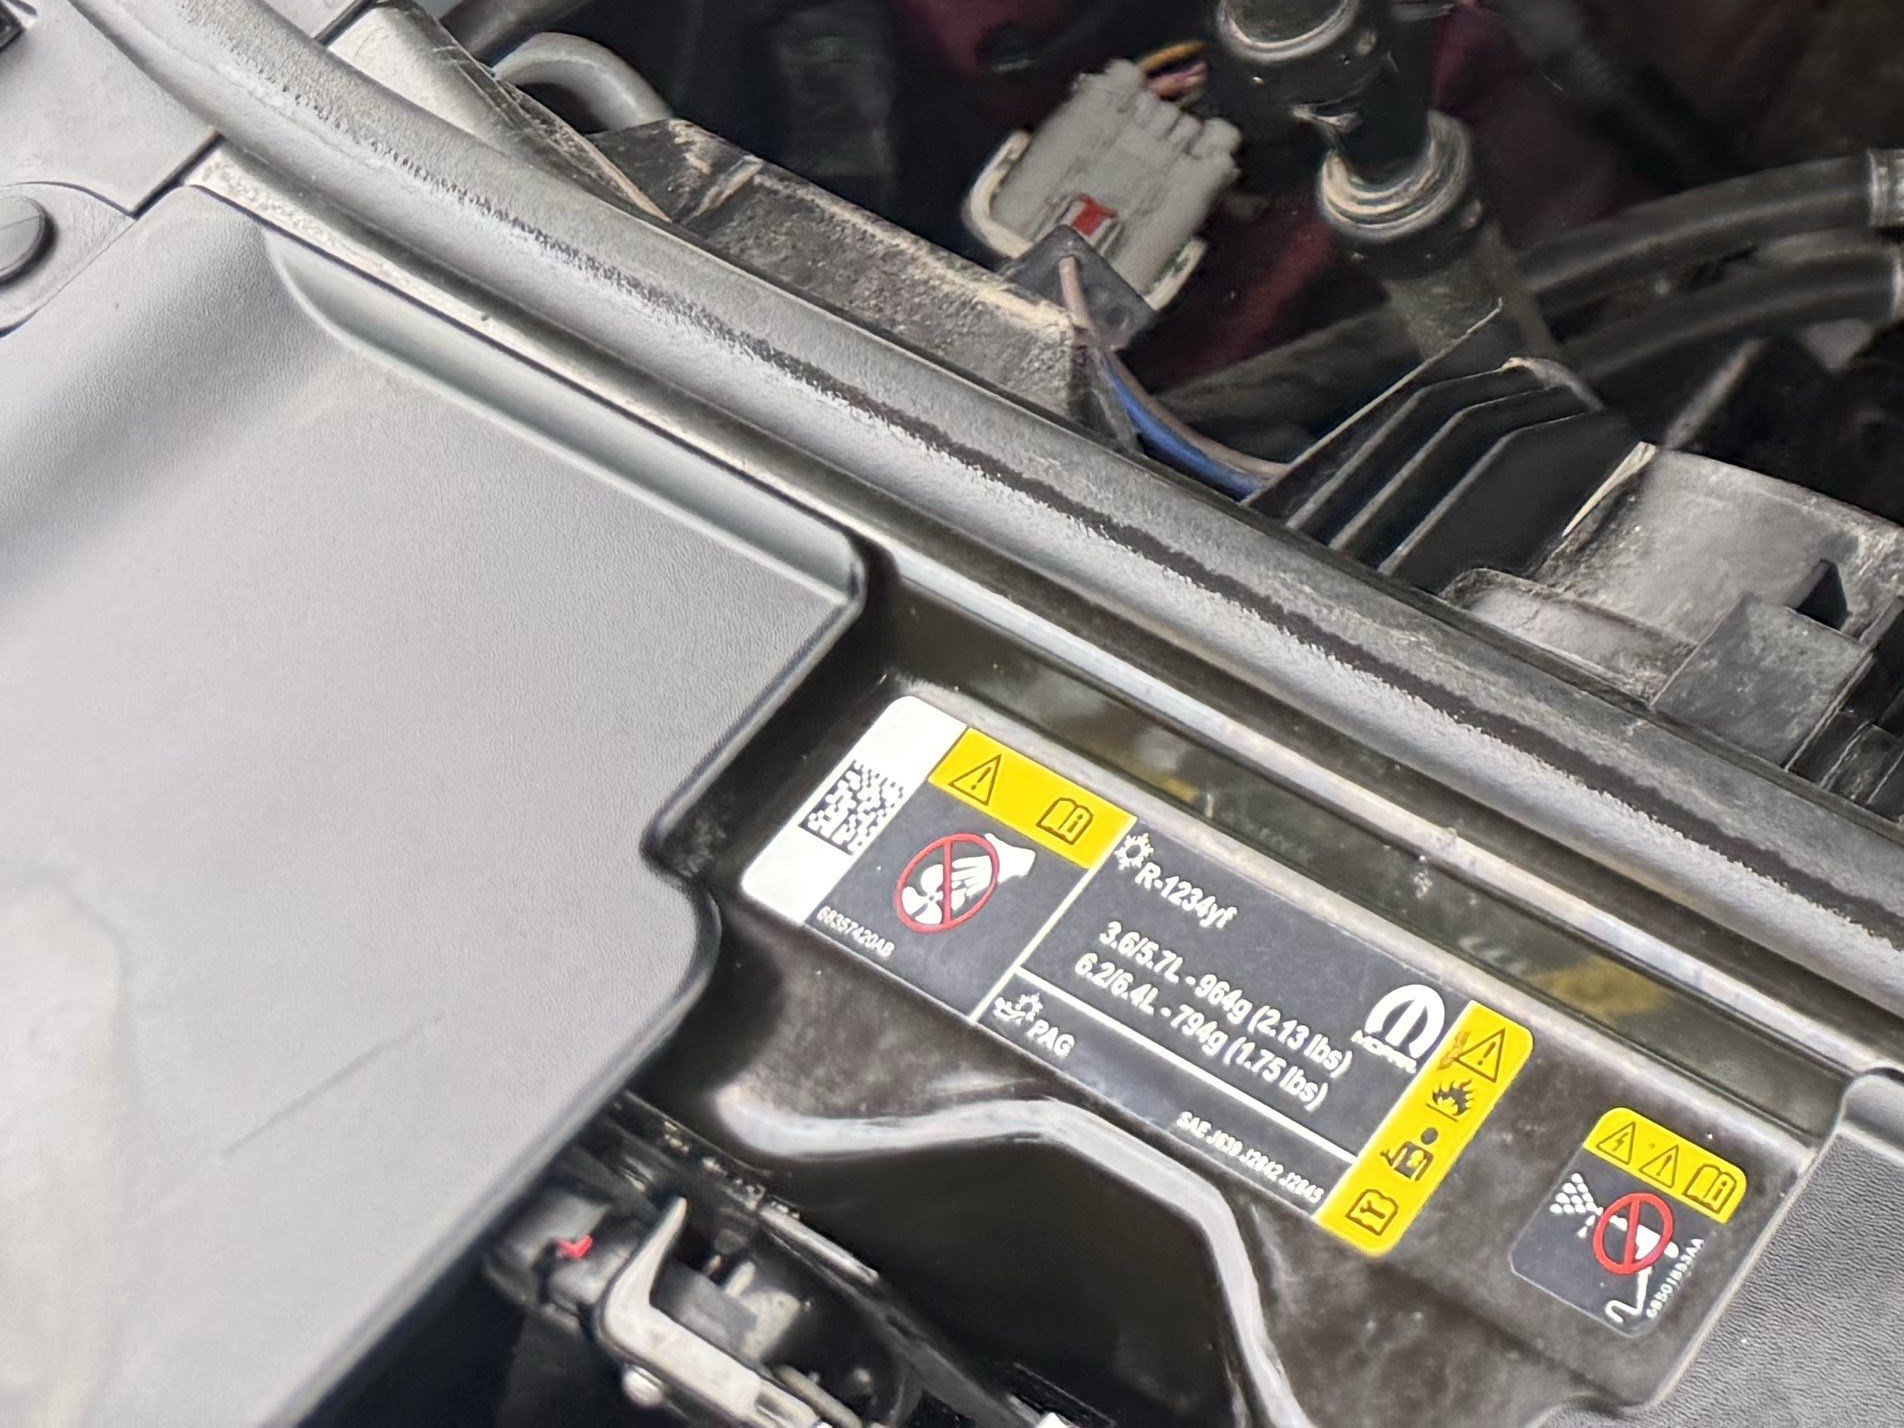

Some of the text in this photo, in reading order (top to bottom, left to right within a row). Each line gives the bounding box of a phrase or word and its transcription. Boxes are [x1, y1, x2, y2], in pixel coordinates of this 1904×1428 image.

[1134, 862, 1239, 929] R-1234yf
[1074, 952, 1160, 1018] 6.2/6.4L
[1170, 1003, 1229, 1056] 794g
[1222, 1036, 1288, 1082] (1.75
[1279, 1065, 1330, 1112] lbs)
[1100, 921, 1185, 985] 3.6/5.7L
[1195, 973, 1253, 1026] 964g
[1249, 1005, 1310, 1051] (2.13
[1303, 1034, 1353, 1078] lbs)
[1025, 1018, 1076, 1059] PAG
[1176, 1110, 1212, 1139] SAE
